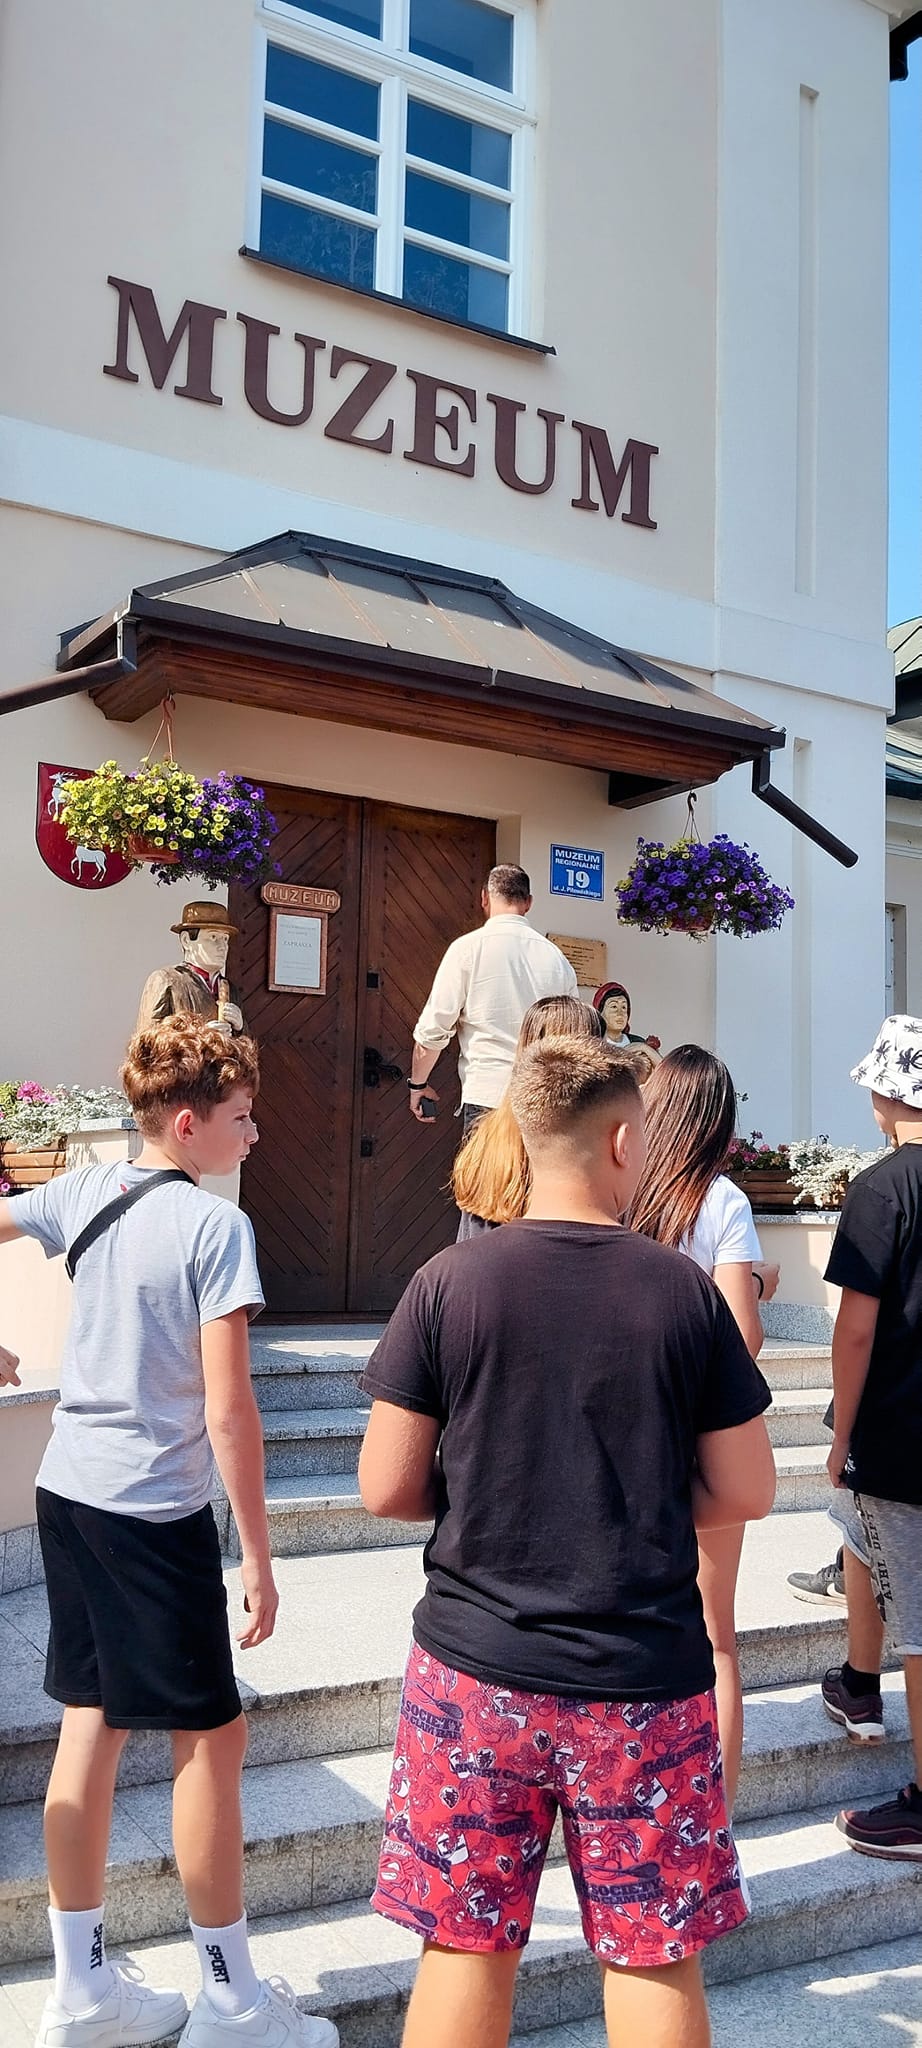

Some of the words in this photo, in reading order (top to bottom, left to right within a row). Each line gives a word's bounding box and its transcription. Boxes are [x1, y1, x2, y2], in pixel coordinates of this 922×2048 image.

[103, 275, 660, 530] MUZEUM
[555, 849, 600, 864] MUZEUM
[555, 857, 600, 871] REGIONALNE
[566, 869, 590, 889] 19
[268, 887, 336, 907] MUZEUM
[867, 1510, 882, 1551] DEPT
[878, 1559, 893, 1602] ATHL
[405, 1700, 462, 1731] SOCIETY
[585, 1806, 656, 1821] CRABS
[591, 1877, 661, 1896] SOCIETY
[90, 1922, 103, 1970] SPORT
[205, 1944, 231, 1985] SPORT
